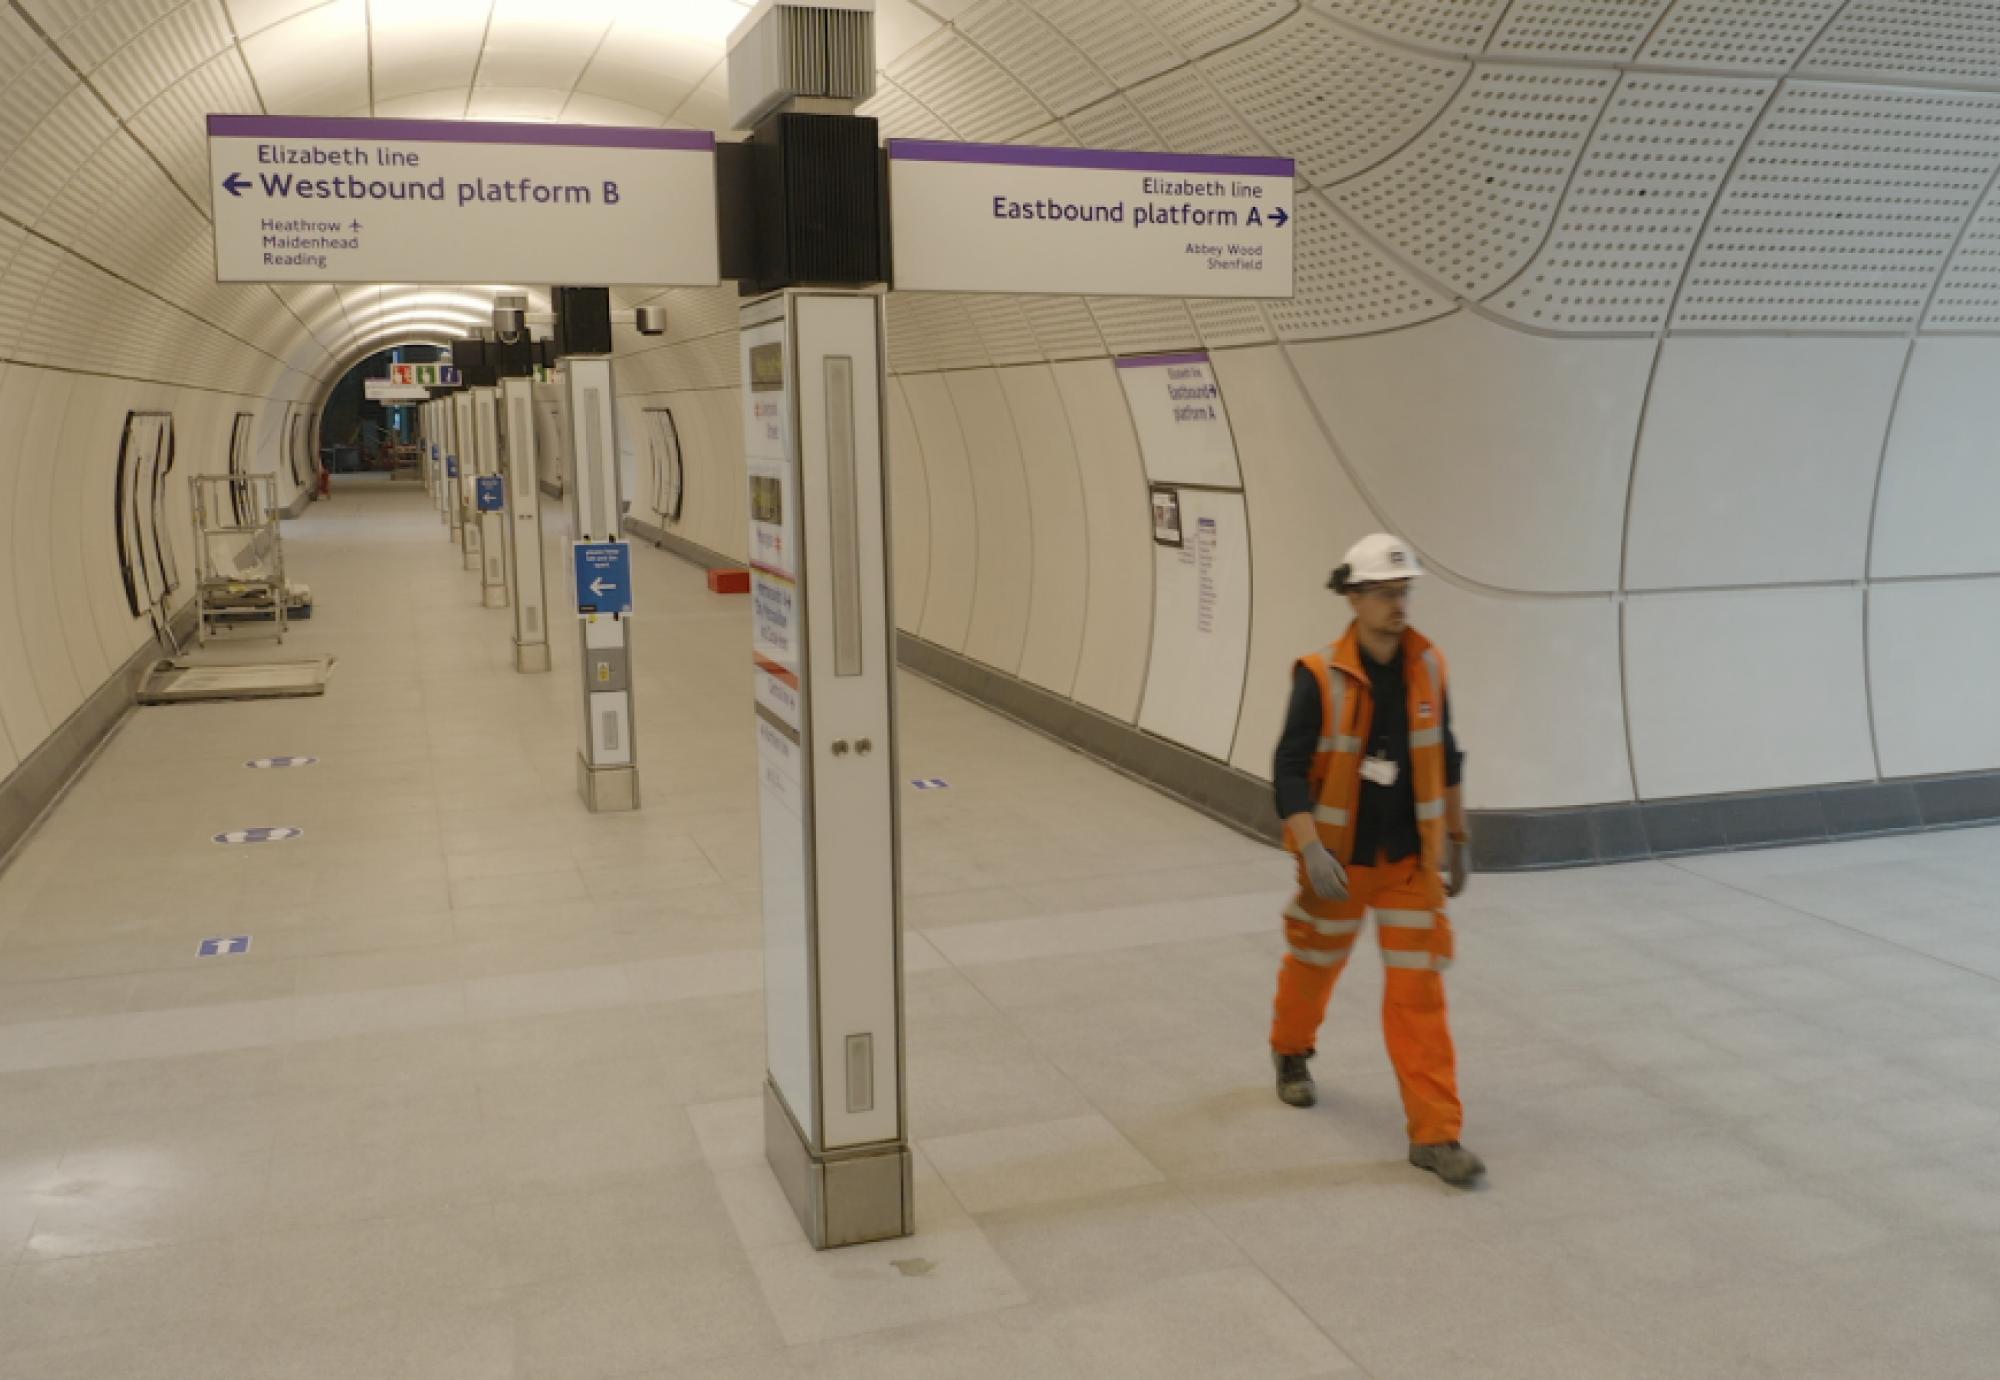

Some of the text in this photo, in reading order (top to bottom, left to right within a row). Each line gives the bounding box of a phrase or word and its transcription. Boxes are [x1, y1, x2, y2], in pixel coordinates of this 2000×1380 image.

[257, 144, 420, 168] Elizabeth line
[258, 172, 621, 207] Westbound platform B
[1142, 176, 1263, 199] Elizabeth line
[992, 195, 1263, 229] Eastbound platform A
[261, 218, 341, 232] Heathrow
[263, 235, 359, 249] Maidenhead
[1184, 242, 1263, 257] Abbey Wood
[263, 252, 328, 269] Reading
[1206, 256, 1263, 271] Shenfield
